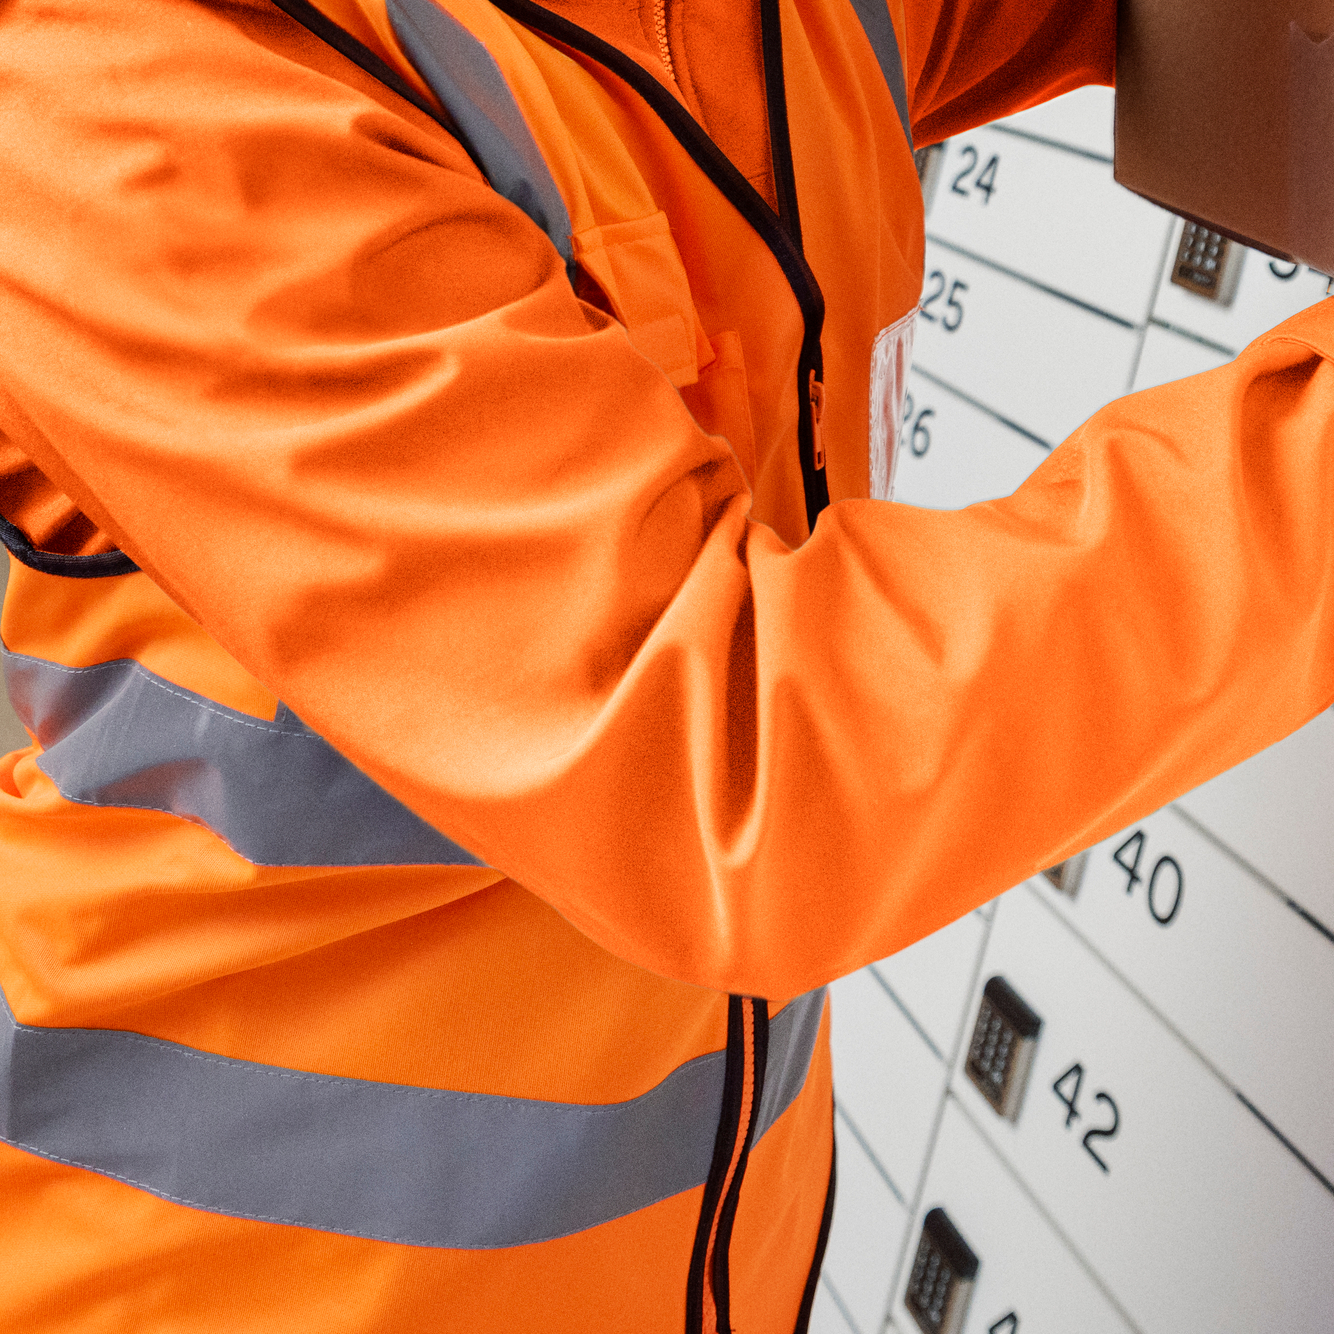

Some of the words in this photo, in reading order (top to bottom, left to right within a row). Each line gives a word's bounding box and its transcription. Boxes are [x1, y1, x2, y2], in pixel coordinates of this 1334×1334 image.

[950, 144, 1001, 206] 24
[920, 269, 968, 333] 25
[1113, 829, 1184, 927] 40
[1052, 1063, 1120, 1173] 42
